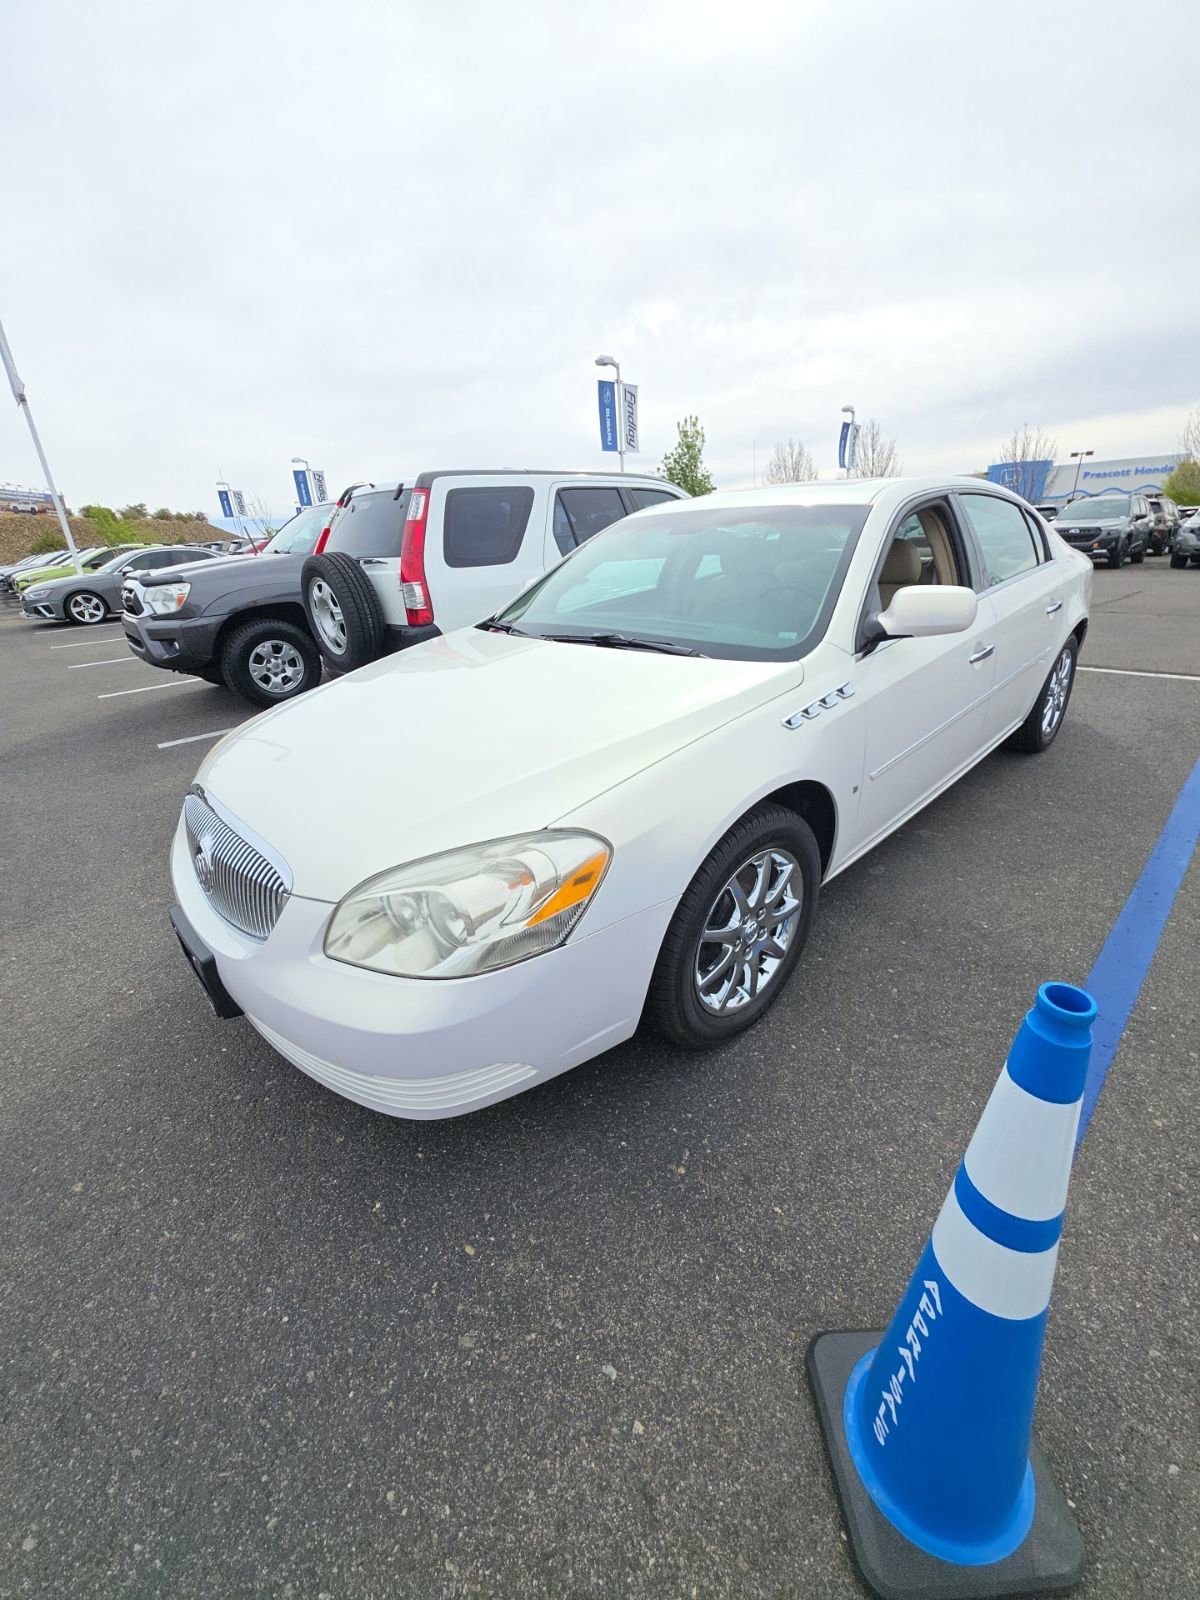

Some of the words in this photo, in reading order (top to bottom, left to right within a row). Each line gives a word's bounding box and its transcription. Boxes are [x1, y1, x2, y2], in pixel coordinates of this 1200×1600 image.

[624, 388, 637, 449] Findlay
[1083, 469, 1131, 480] Prescott
[1134, 464, 1175, 476] Honda
[872, 1280, 943, 1446] APPRAISALS
